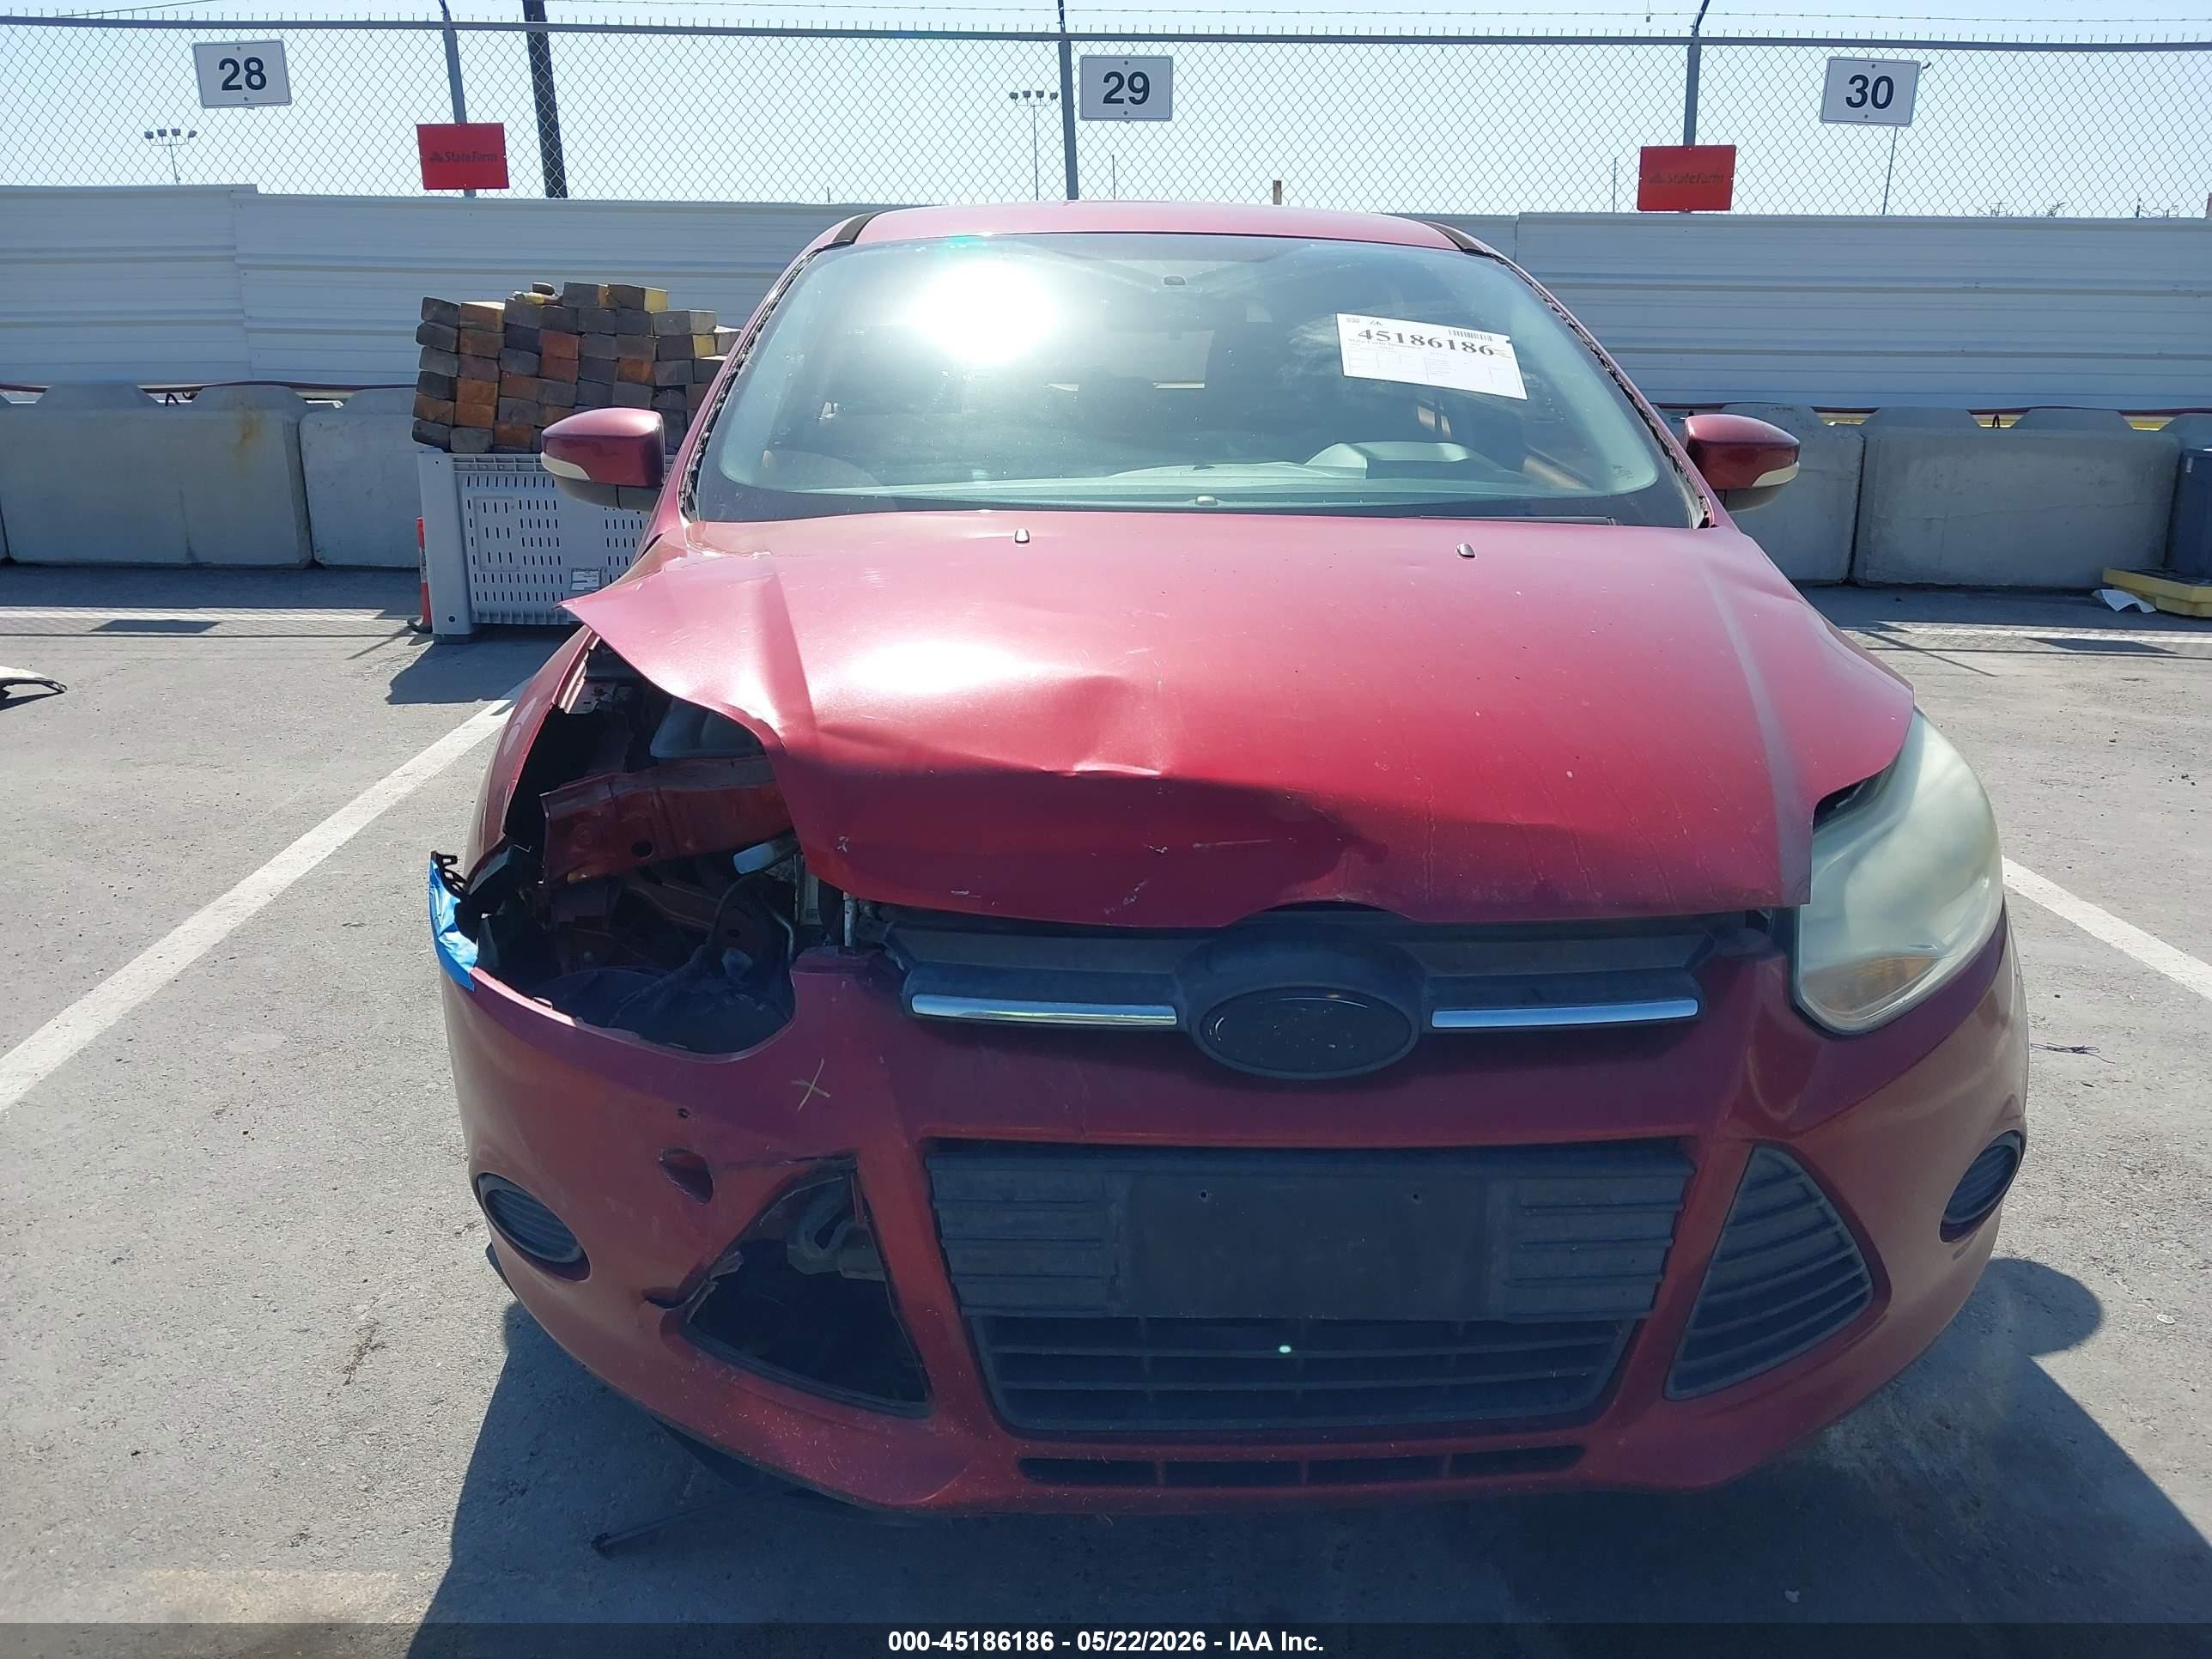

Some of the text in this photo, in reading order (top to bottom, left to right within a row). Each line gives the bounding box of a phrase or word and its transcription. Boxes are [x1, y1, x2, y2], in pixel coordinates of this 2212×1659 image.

[218, 57, 267, 91] 28
[1102, 70, 1150, 106] 29
[1845, 74, 1894, 110] 30
[1358, 329, 1495, 356] 45186186
